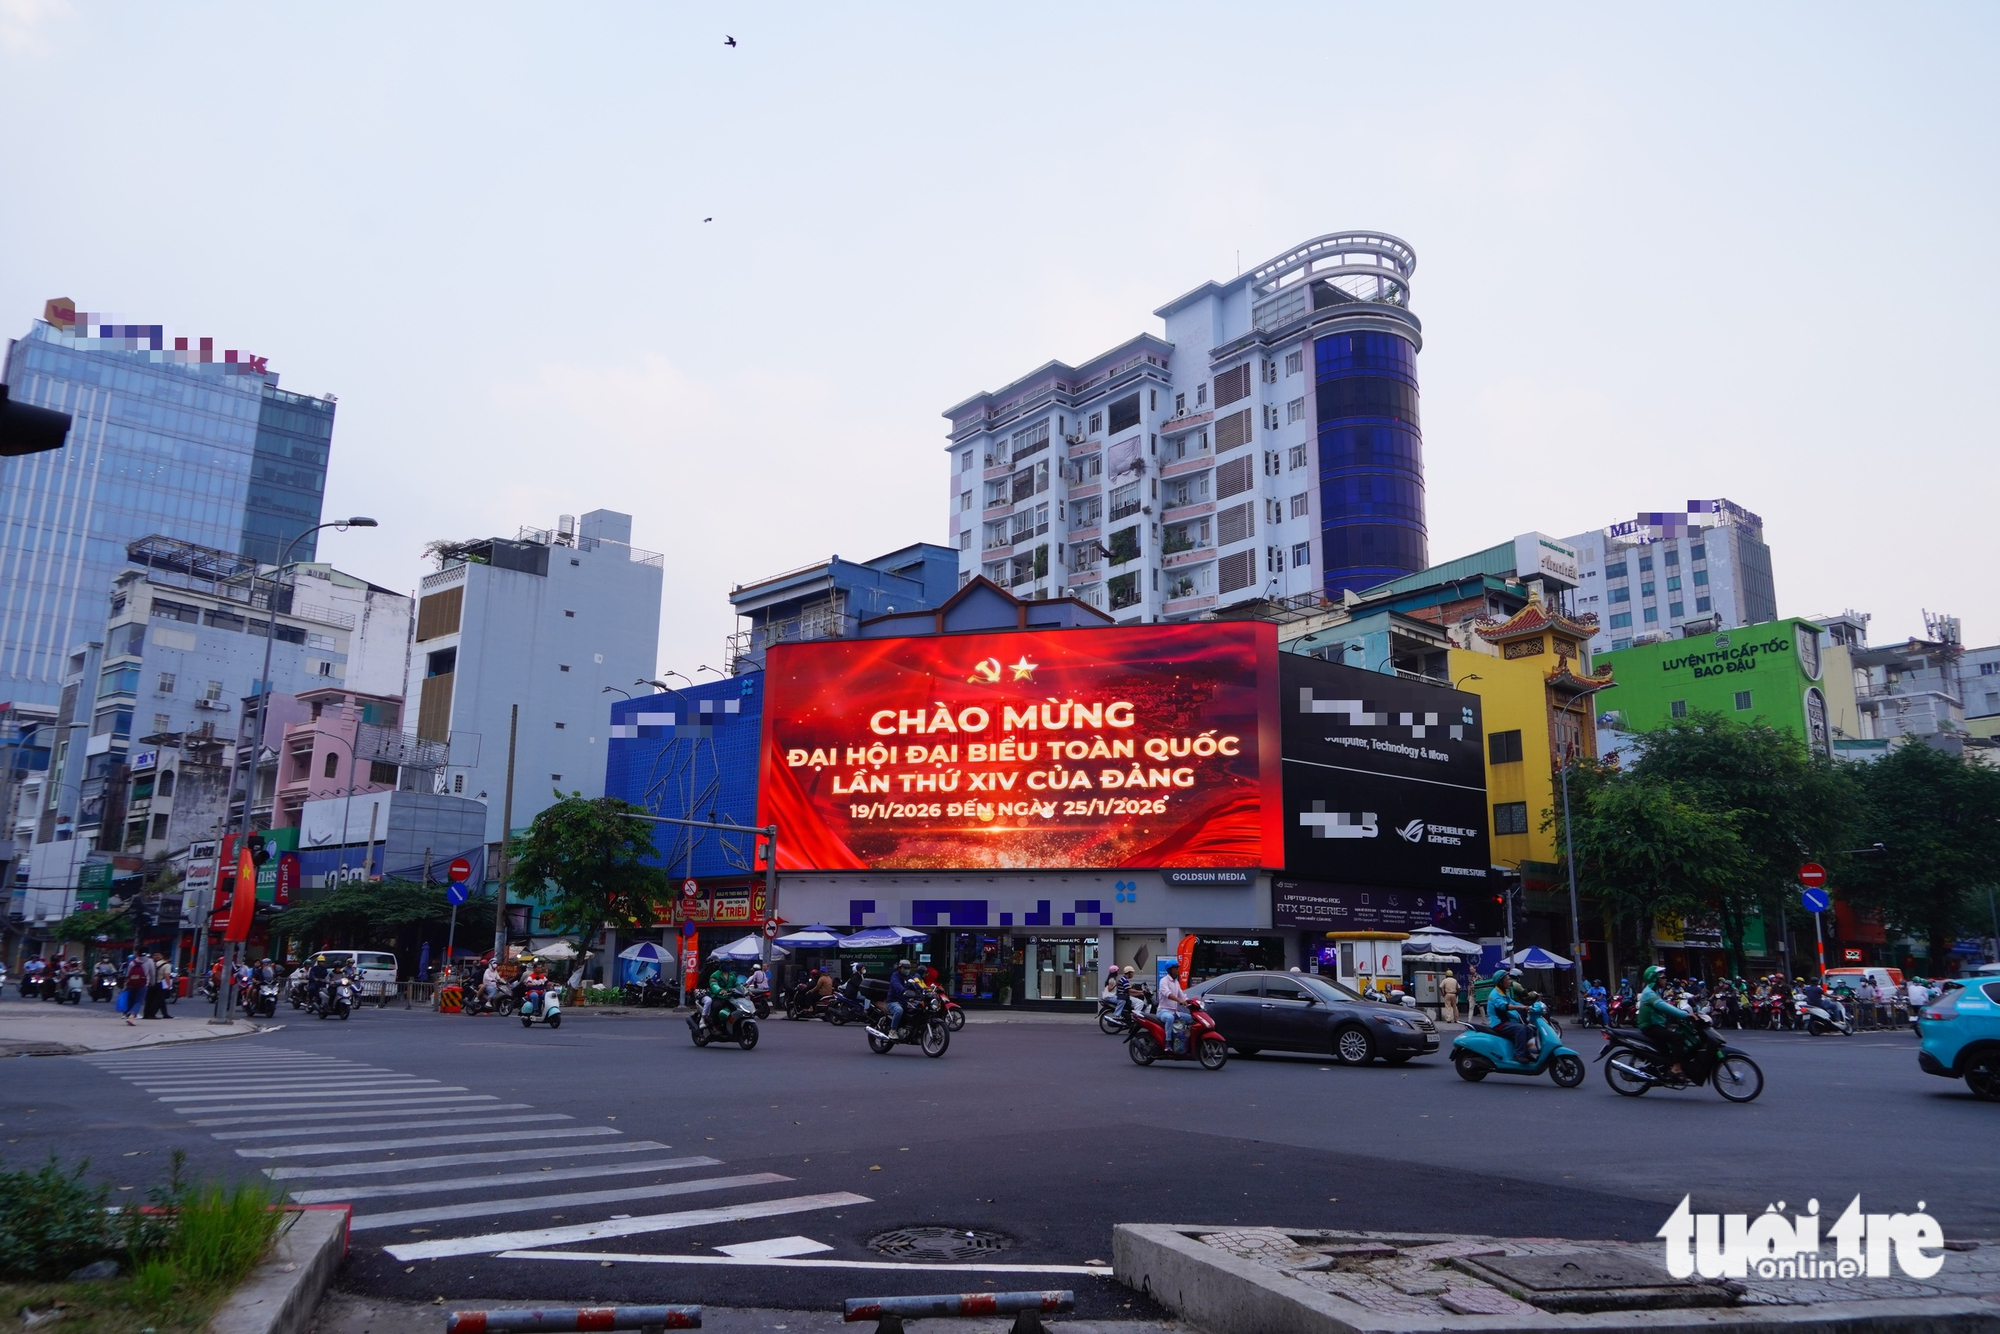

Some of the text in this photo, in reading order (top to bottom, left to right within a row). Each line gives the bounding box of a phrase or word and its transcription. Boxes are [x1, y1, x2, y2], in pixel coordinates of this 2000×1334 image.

[1662, 637, 1789, 671] LUYỆN THI CẤP TỐC
[1694, 658, 1756, 678] BAO ĐẬU
[870, 697, 1135, 736] CHÀO MỪNG
[786, 729, 1240, 772] ĐẠI HỘI ĐẠI BIỂU TOÀN QUỐC
[1371, 738, 1419, 759] Technology
[1420, 747, 1427, 758] &
[1428, 750, 1449, 762] More
[832, 762, 1195, 794] LẦN THỨ XIV CỦA ĐẢNG
[850, 798, 1167, 820] 19/1/2026 ĐẾN NGÀY 25/1/2026
[1426, 824, 1478, 838] REPUBLIC OF
[1427, 835, 1461, 846] GAMERS
[1172, 872, 1247, 881] GOLDSUN MEDIA
[716, 900, 724, 918] 2
[725, 904, 747, 919] TRIỆU
[1277, 903, 1298, 913] RTX
[1299, 905, 1313, 914] 50
[1314, 906, 1348, 916] SERIES
[1241, 939, 1259, 947] ASUS
